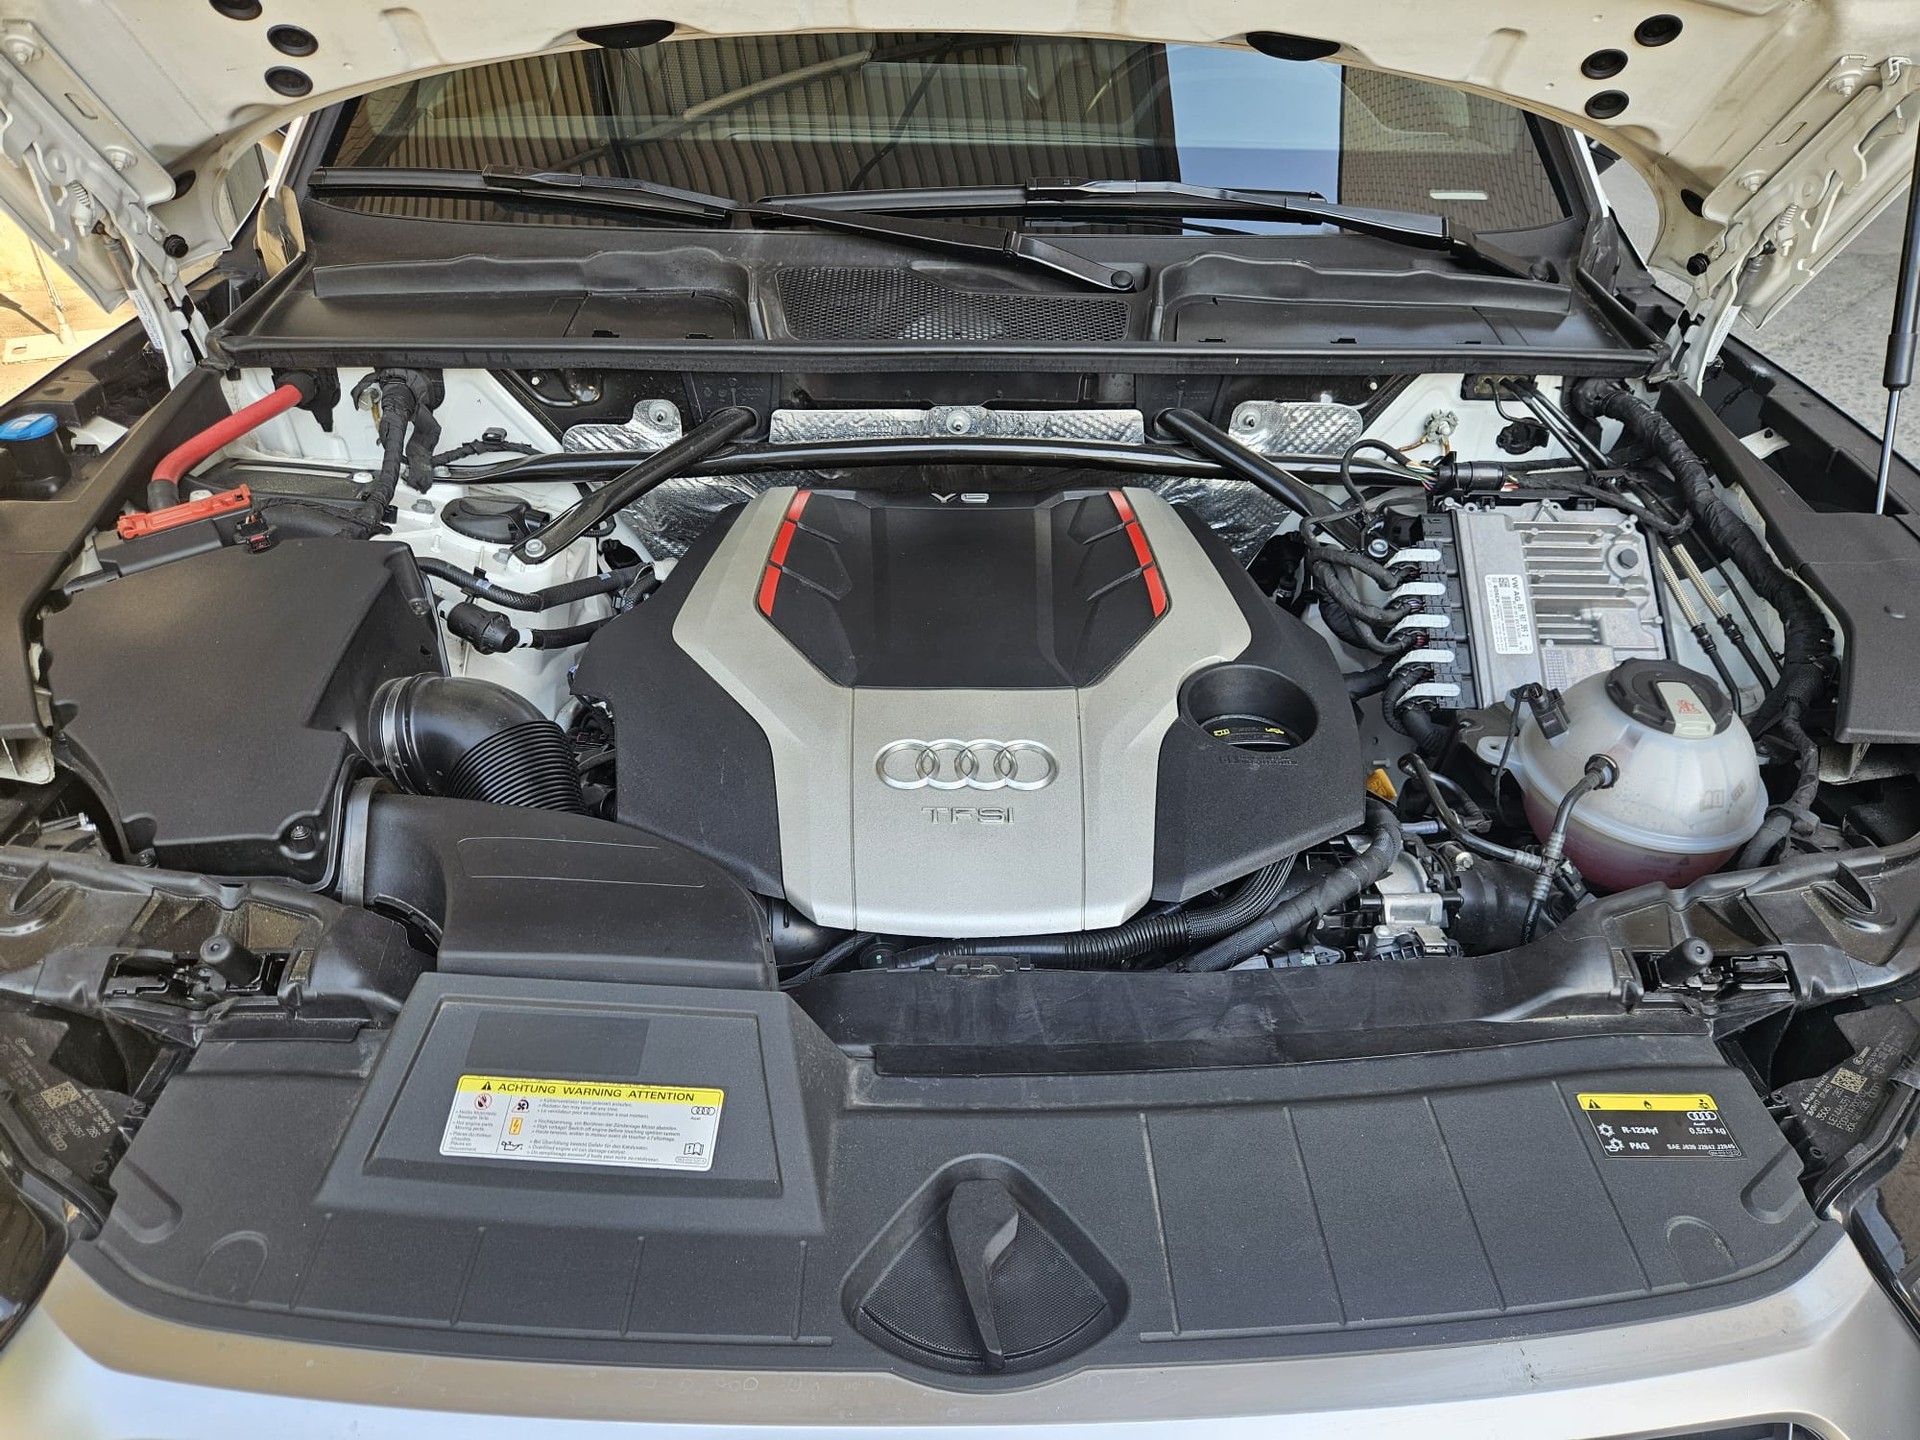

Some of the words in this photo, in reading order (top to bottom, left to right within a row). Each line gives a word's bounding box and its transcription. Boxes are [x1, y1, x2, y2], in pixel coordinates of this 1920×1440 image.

[1514, 590, 1521, 602] AG
[921, 806, 1014, 824] TFSI
[498, 1082, 556, 1095] ACHTUNG
[563, 1086, 622, 1098] WARNING
[628, 1089, 694, 1102] ATTENTION
[1621, 1126, 1658, 1136] R-1234yf
[1688, 1127, 1713, 1135] 0,525
[1714, 1127, 1726, 1135] kg
